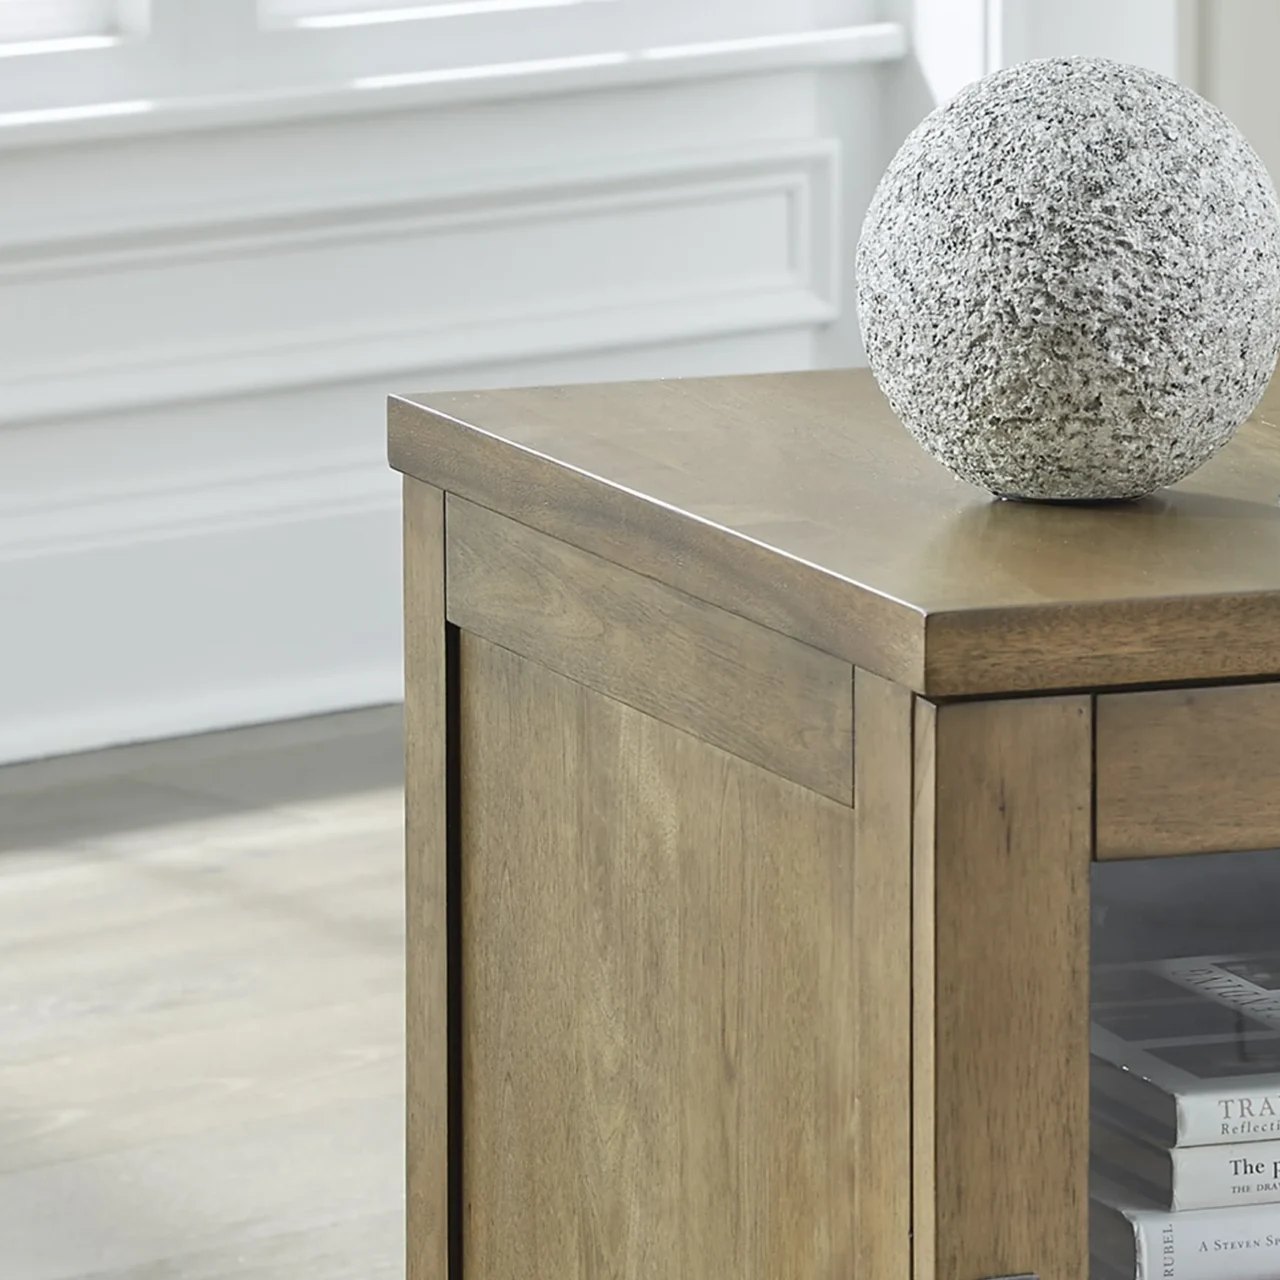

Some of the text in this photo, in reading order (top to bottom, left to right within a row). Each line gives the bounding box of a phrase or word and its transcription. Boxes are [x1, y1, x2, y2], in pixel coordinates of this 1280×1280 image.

[1229, 1158, 1265, 1176] The
[1231, 1185, 1251, 1194] THE
[1163, 1223, 1175, 1277] RUBEL
[1198, 1241, 1208, 1252] A
